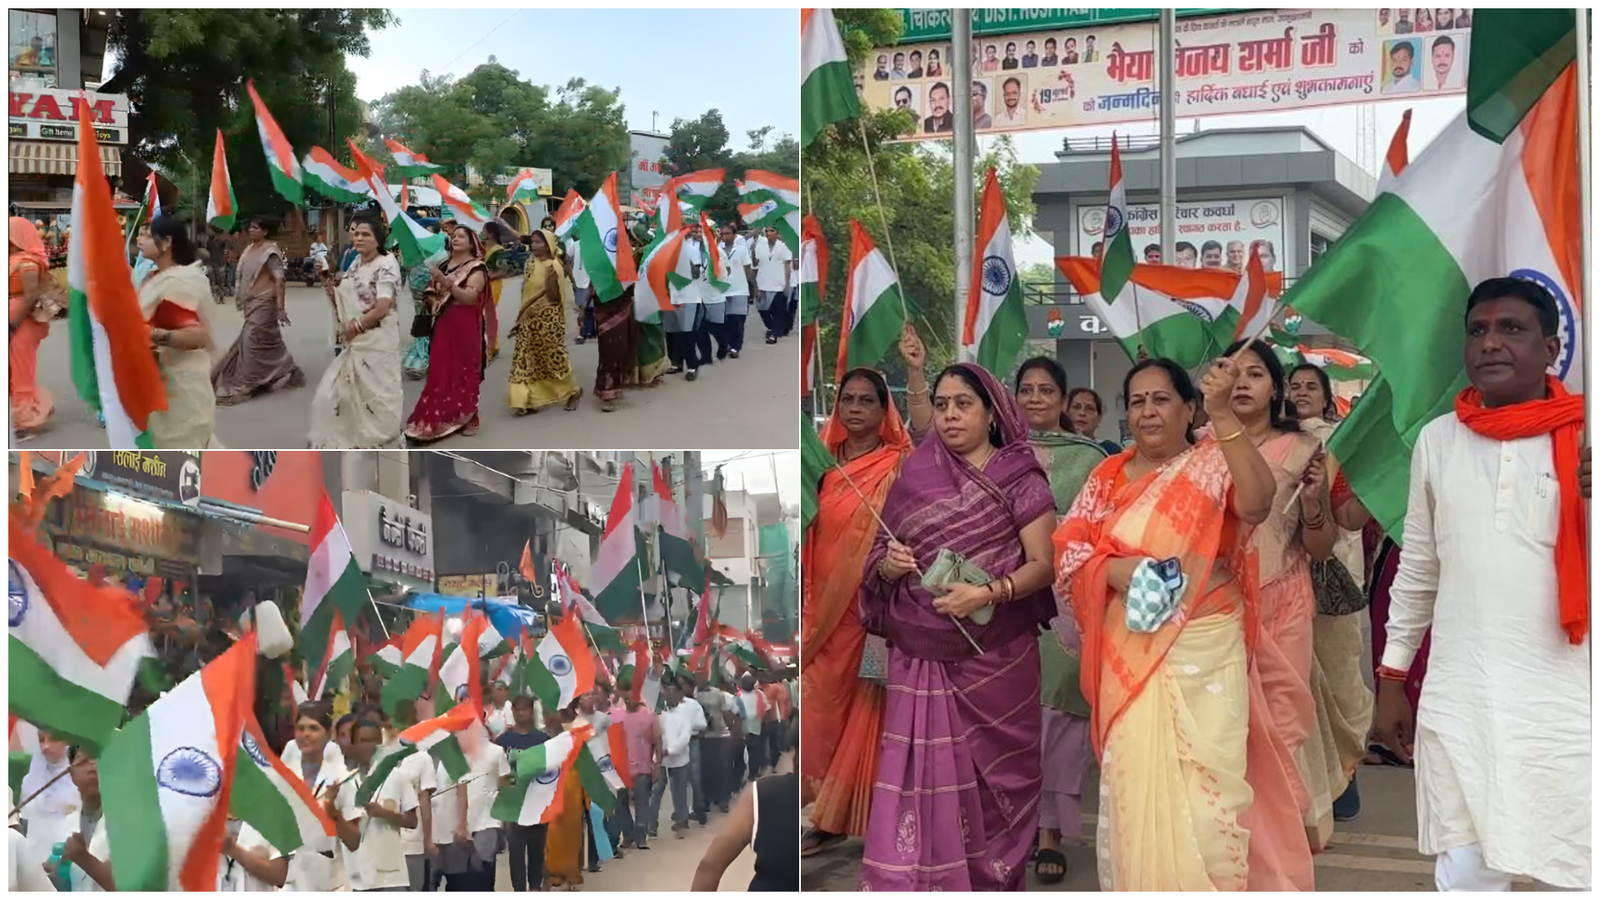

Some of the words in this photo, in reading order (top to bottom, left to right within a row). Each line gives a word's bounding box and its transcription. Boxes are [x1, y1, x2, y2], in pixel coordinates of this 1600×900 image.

[1237, 25, 1294, 71] शर्मा
[1300, 22, 1337, 66] जी
[1348, 37, 1364, 55] को
[1039, 88, 1052, 105] 19
